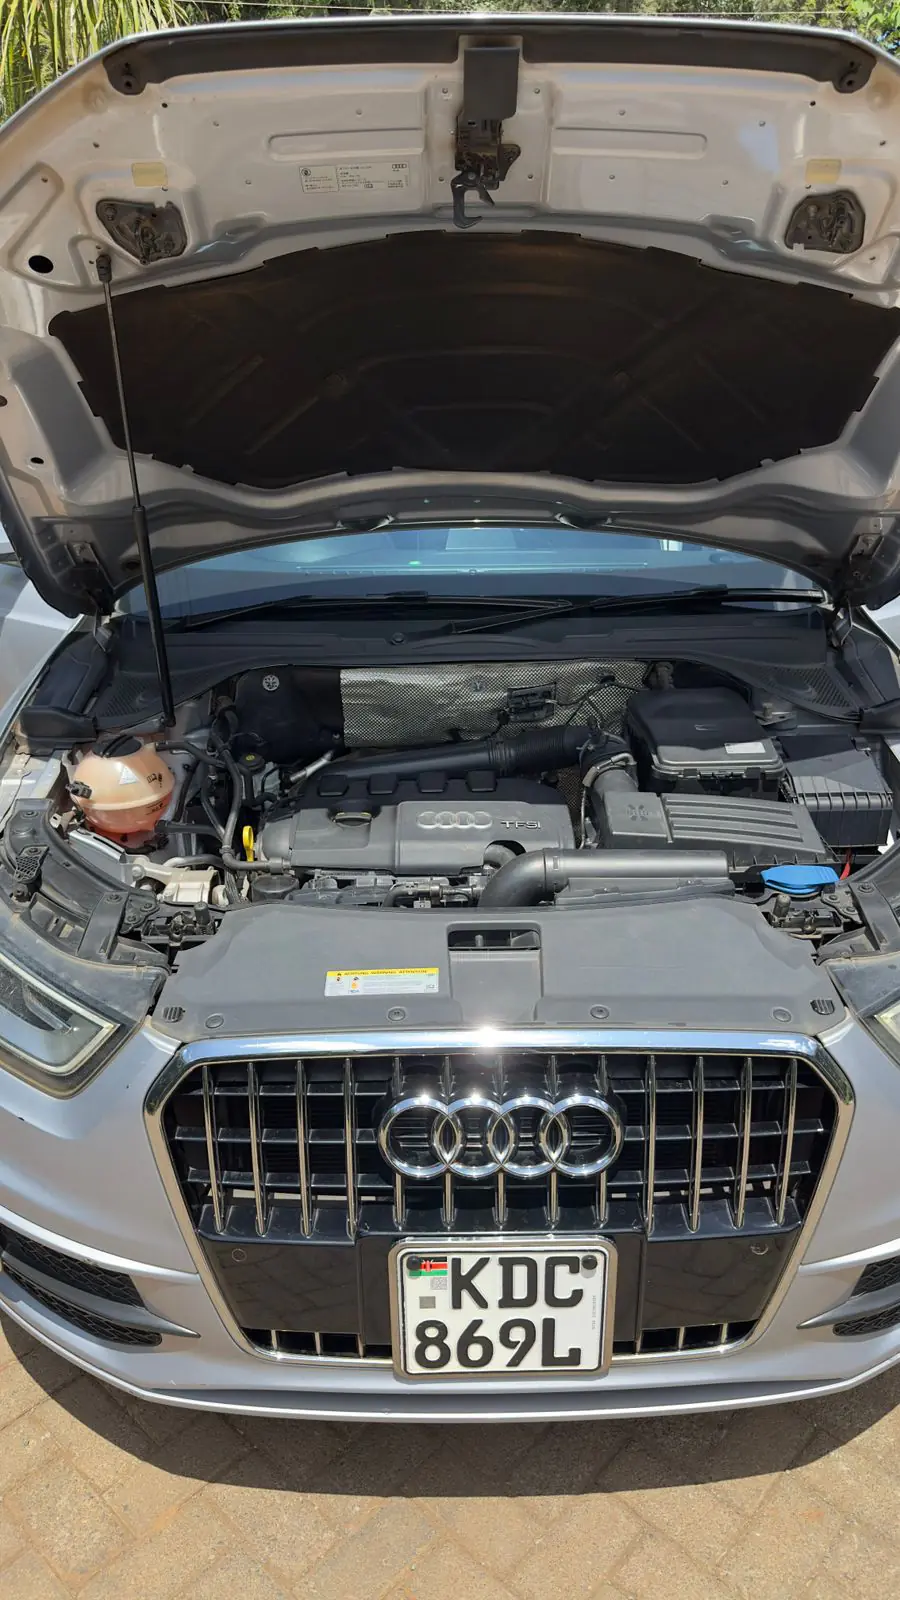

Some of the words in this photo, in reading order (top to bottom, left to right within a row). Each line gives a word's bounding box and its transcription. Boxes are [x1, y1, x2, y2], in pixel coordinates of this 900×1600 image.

[500, 820, 541, 829] TFSI
[451, 1256, 584, 1309] KDC
[414, 1317, 582, 1369] 869L
